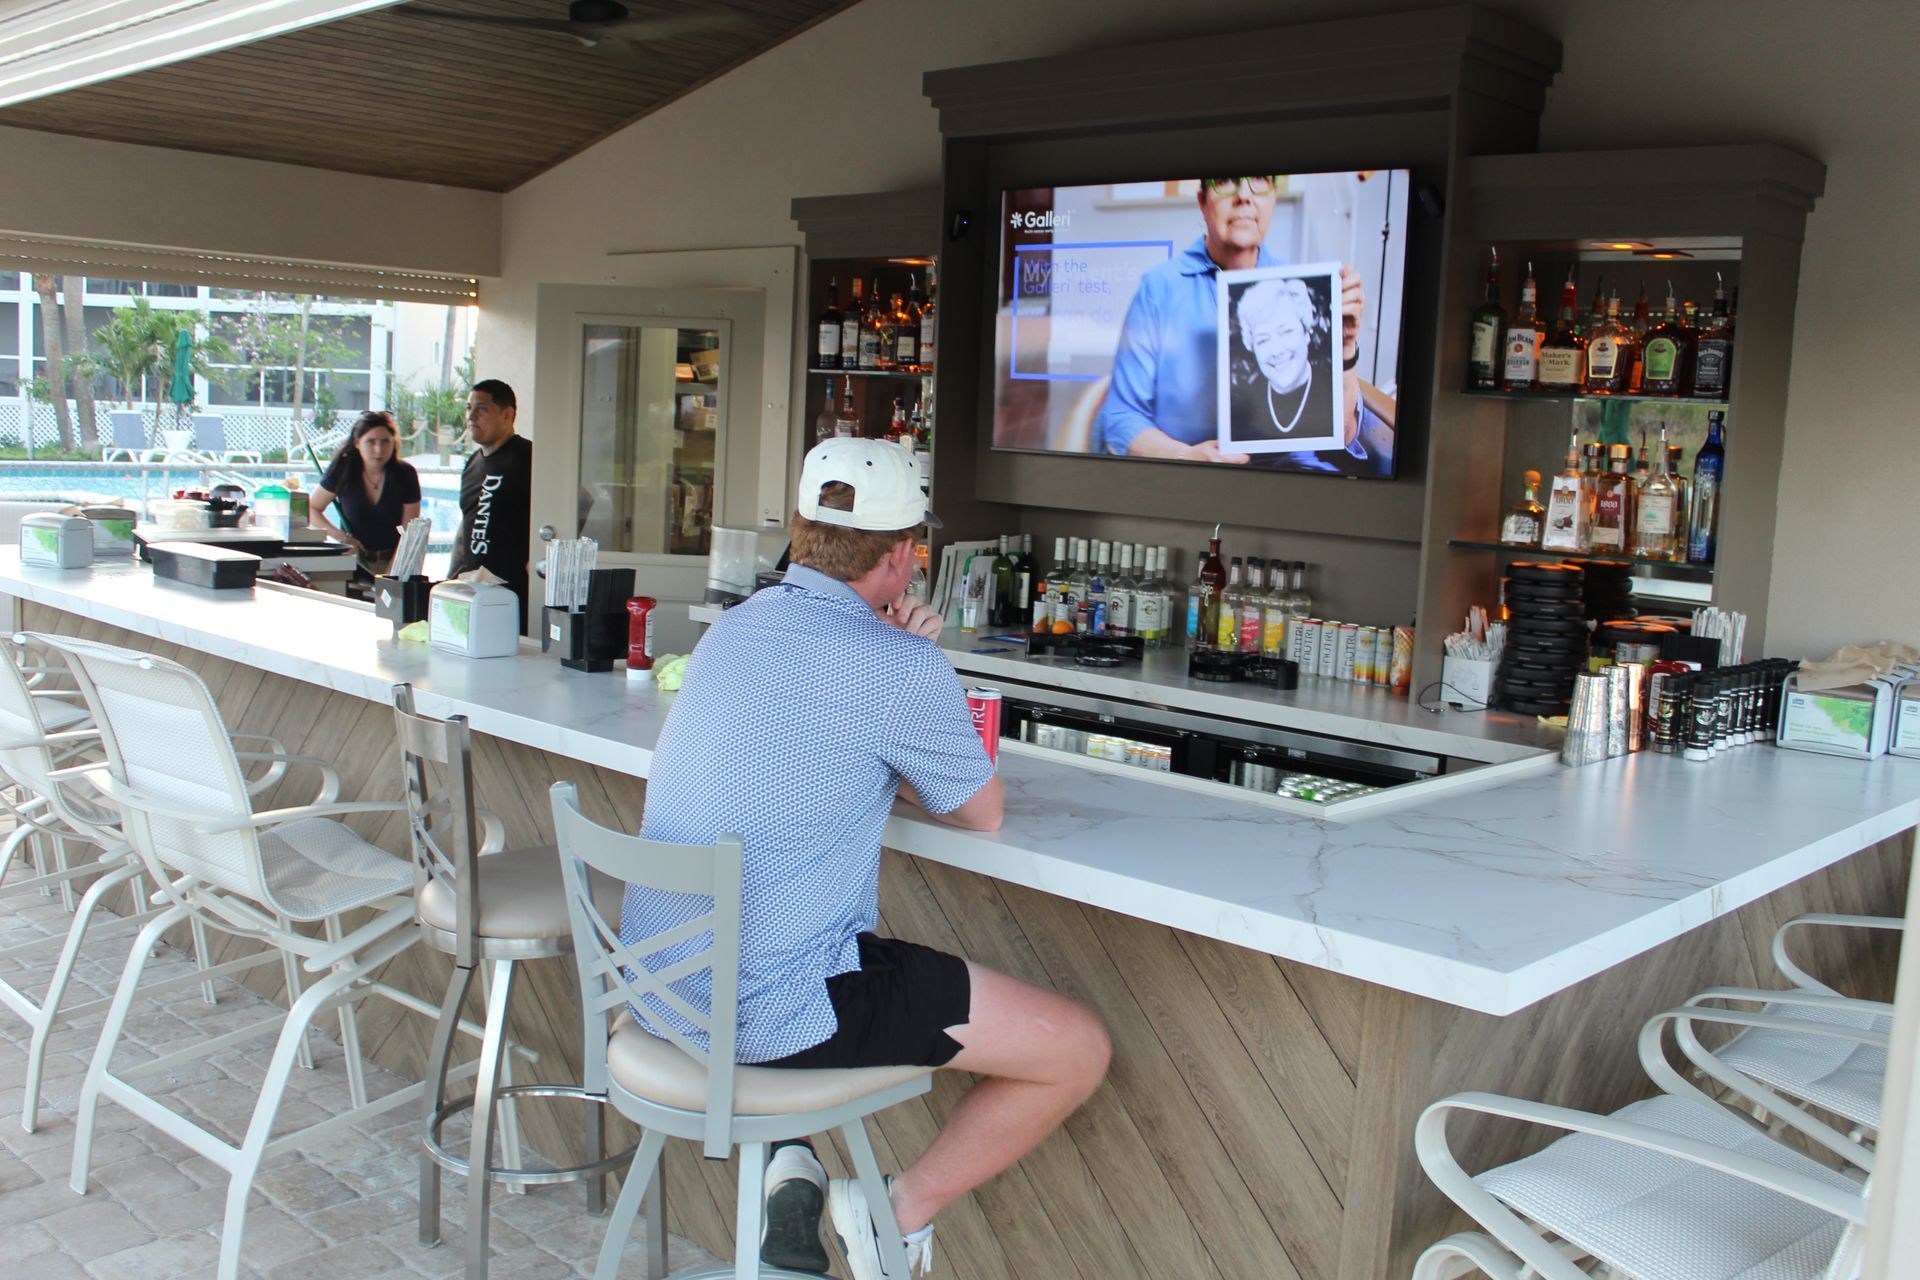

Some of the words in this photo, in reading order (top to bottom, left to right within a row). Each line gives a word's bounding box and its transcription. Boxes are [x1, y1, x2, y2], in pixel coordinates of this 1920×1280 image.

[1024, 210, 1071, 228] Galleri
[1064, 258, 1088, 273] the
[1078, 279, 1112, 295] test,
